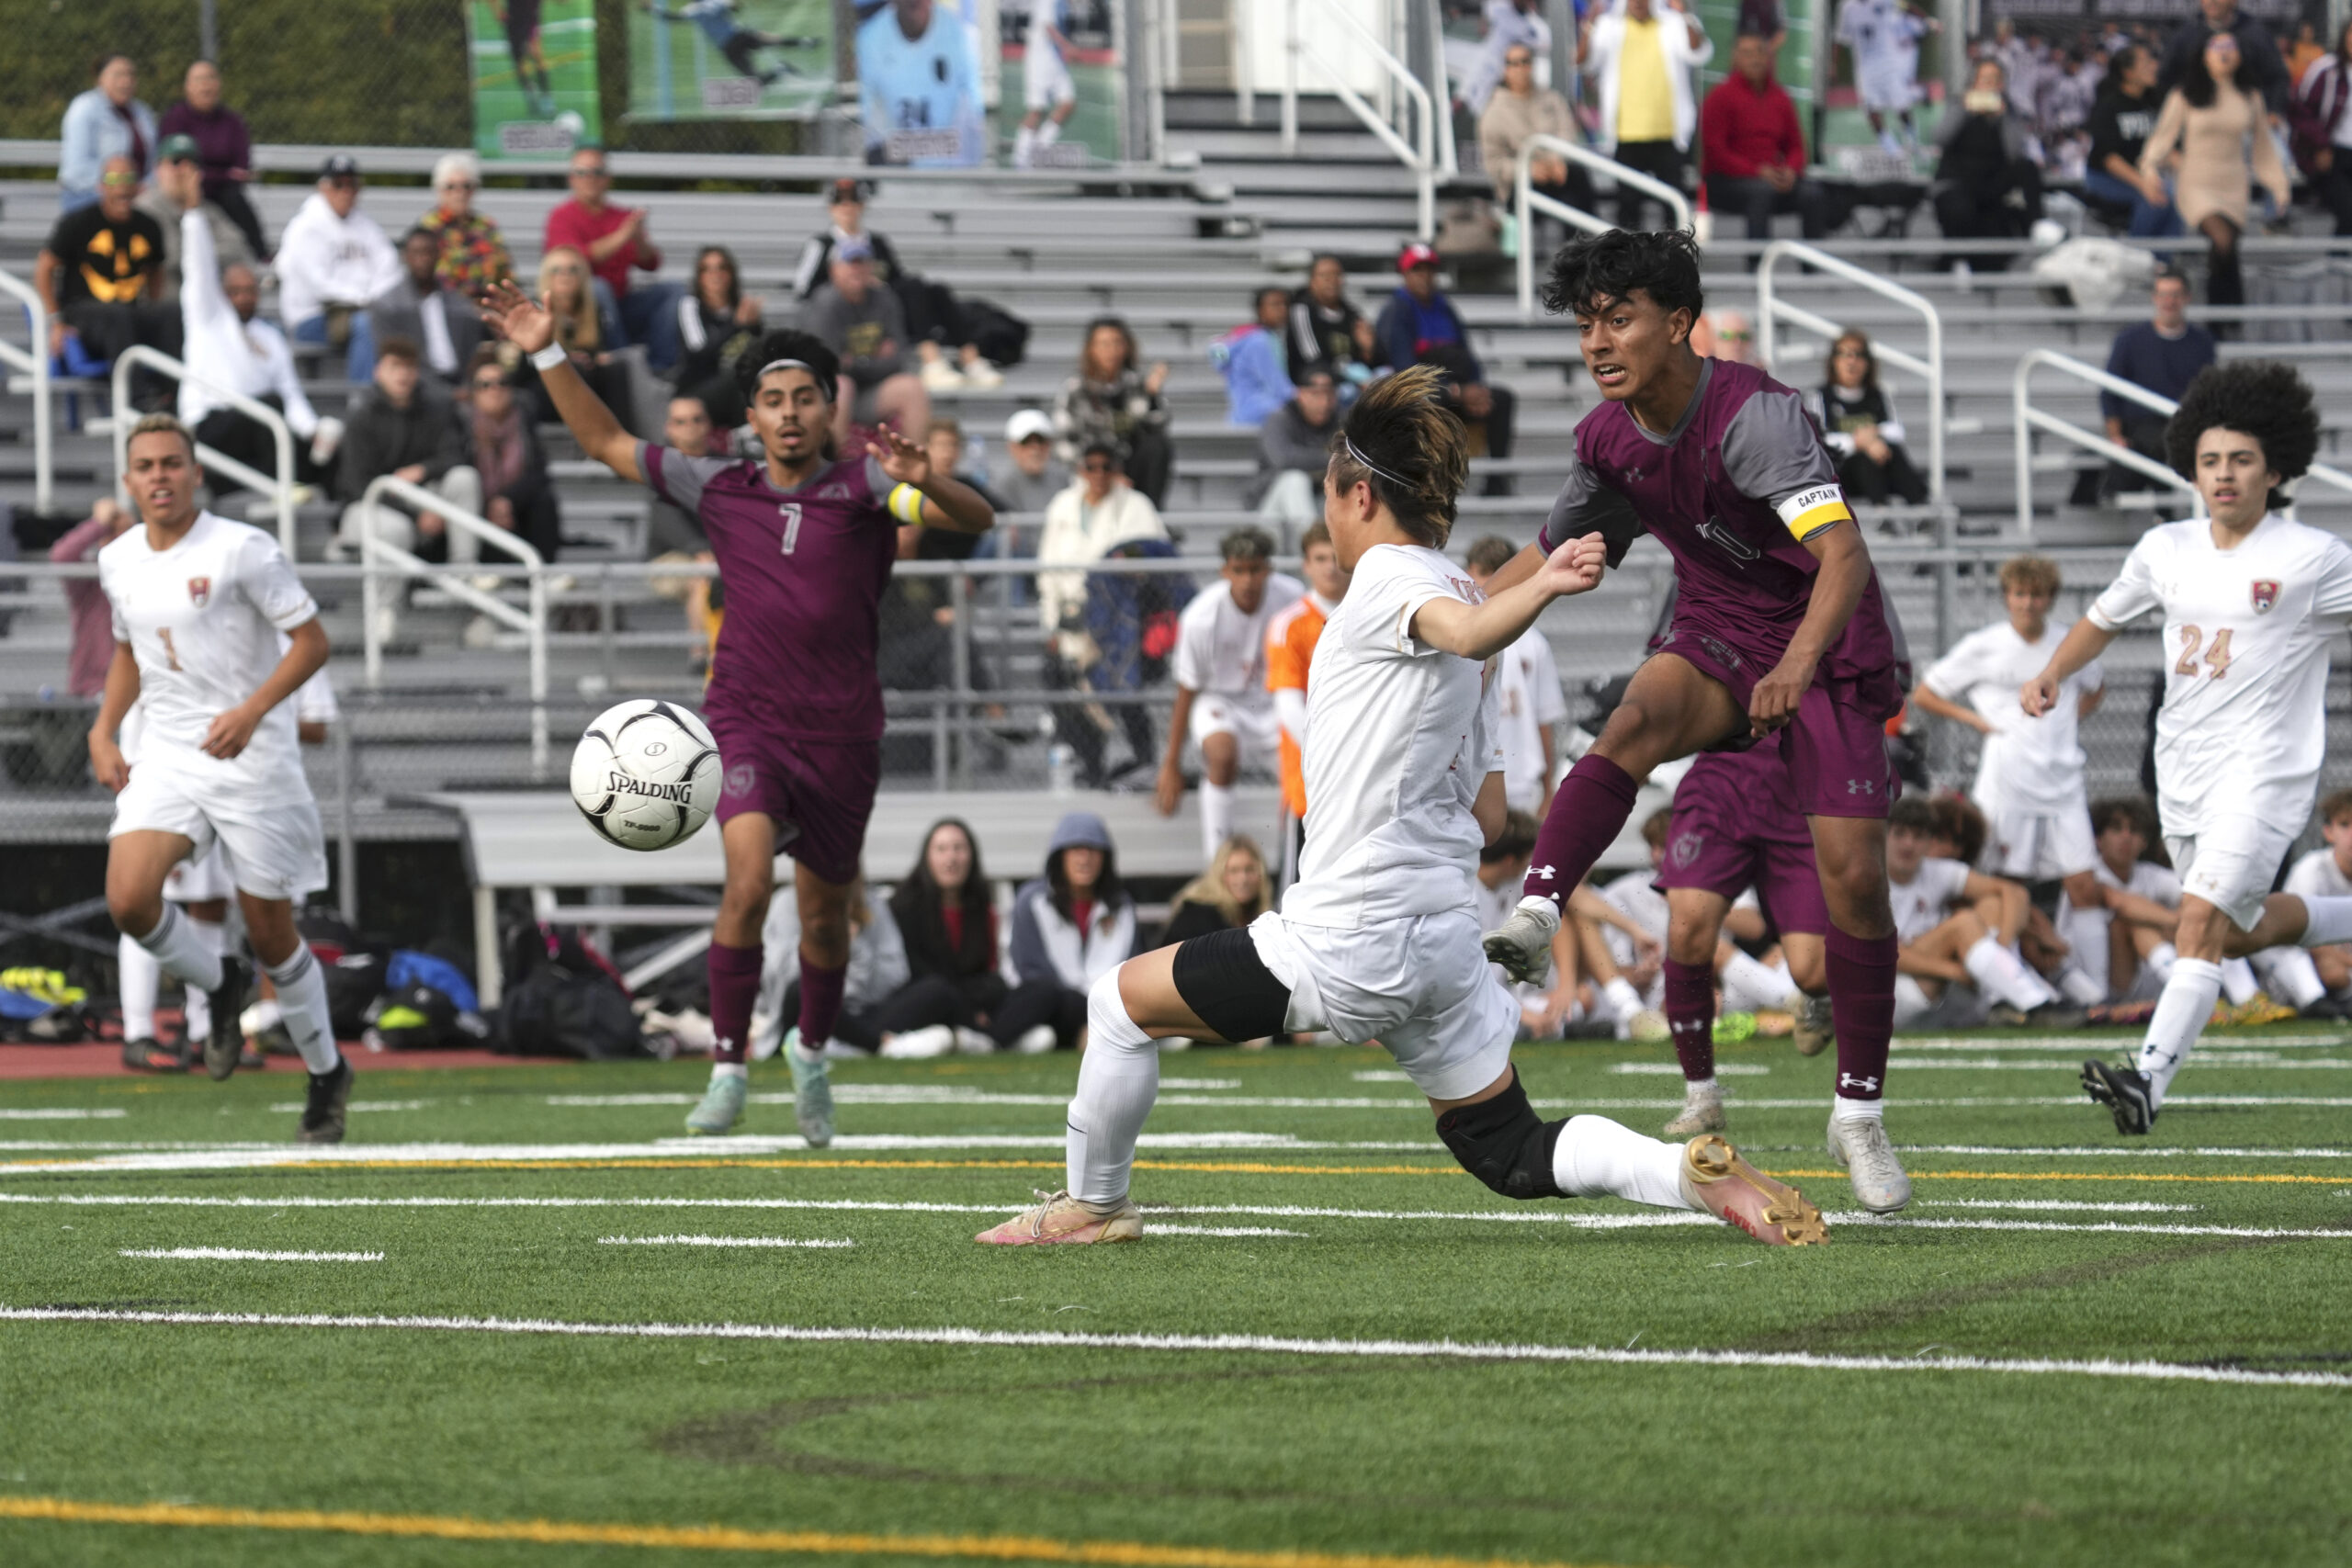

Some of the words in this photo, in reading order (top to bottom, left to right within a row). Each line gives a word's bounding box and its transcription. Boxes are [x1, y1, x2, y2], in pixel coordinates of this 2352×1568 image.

[1798, 489, 1838, 508] CAPTAIN
[778, 502, 802, 556] 7
[155, 626, 184, 671] 1
[2175, 624, 2234, 680] 24
[606, 771, 693, 806] SPALDING
